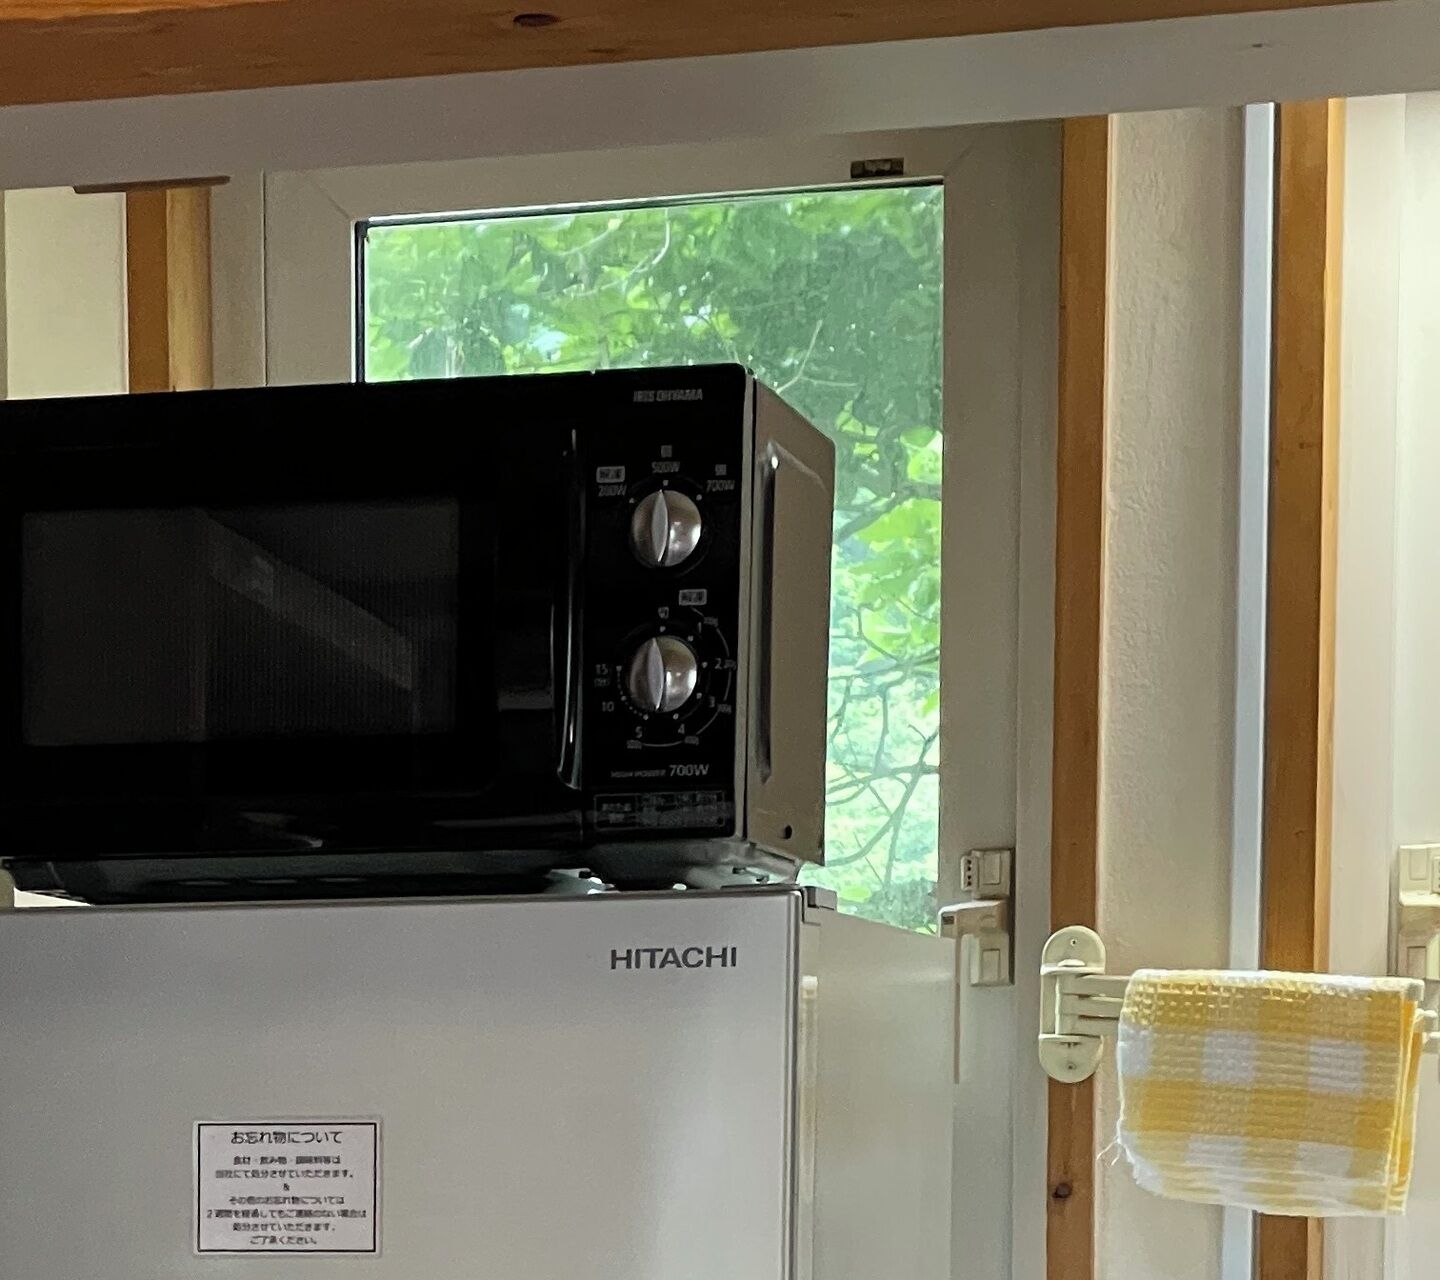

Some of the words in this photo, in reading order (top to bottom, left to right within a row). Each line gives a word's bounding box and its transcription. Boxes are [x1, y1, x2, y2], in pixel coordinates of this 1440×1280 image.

[669, 763, 709, 777] 700W
[610, 946, 737, 970] HITACHI
[230, 1131, 343, 1145] お忘れ物について
[283, 1183, 290, 1191] &
[250, 1236, 318, 1245] ご了承ください。
